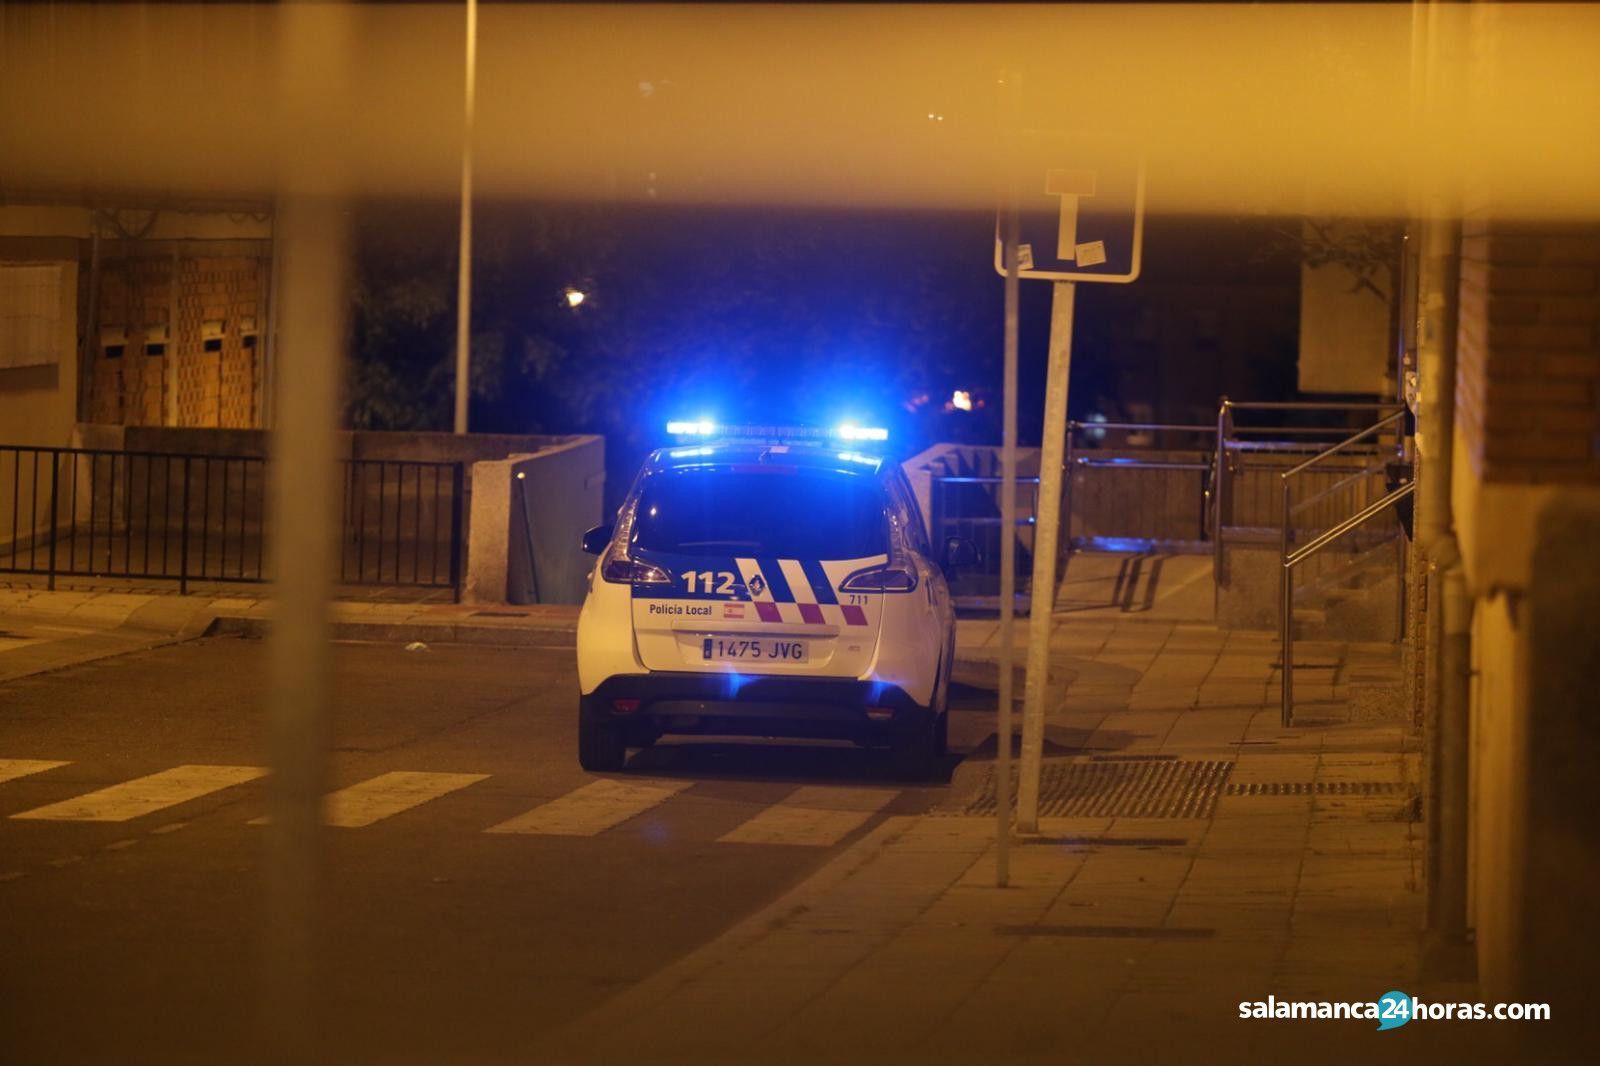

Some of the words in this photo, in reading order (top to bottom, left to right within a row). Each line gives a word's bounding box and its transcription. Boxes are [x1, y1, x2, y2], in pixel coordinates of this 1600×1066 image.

[681, 570, 735, 595] 112
[849, 594, 868, 605] 711
[685, 605, 713, 616] Local
[718, 640, 761, 658] 1475
[768, 642, 803, 660] JVG
